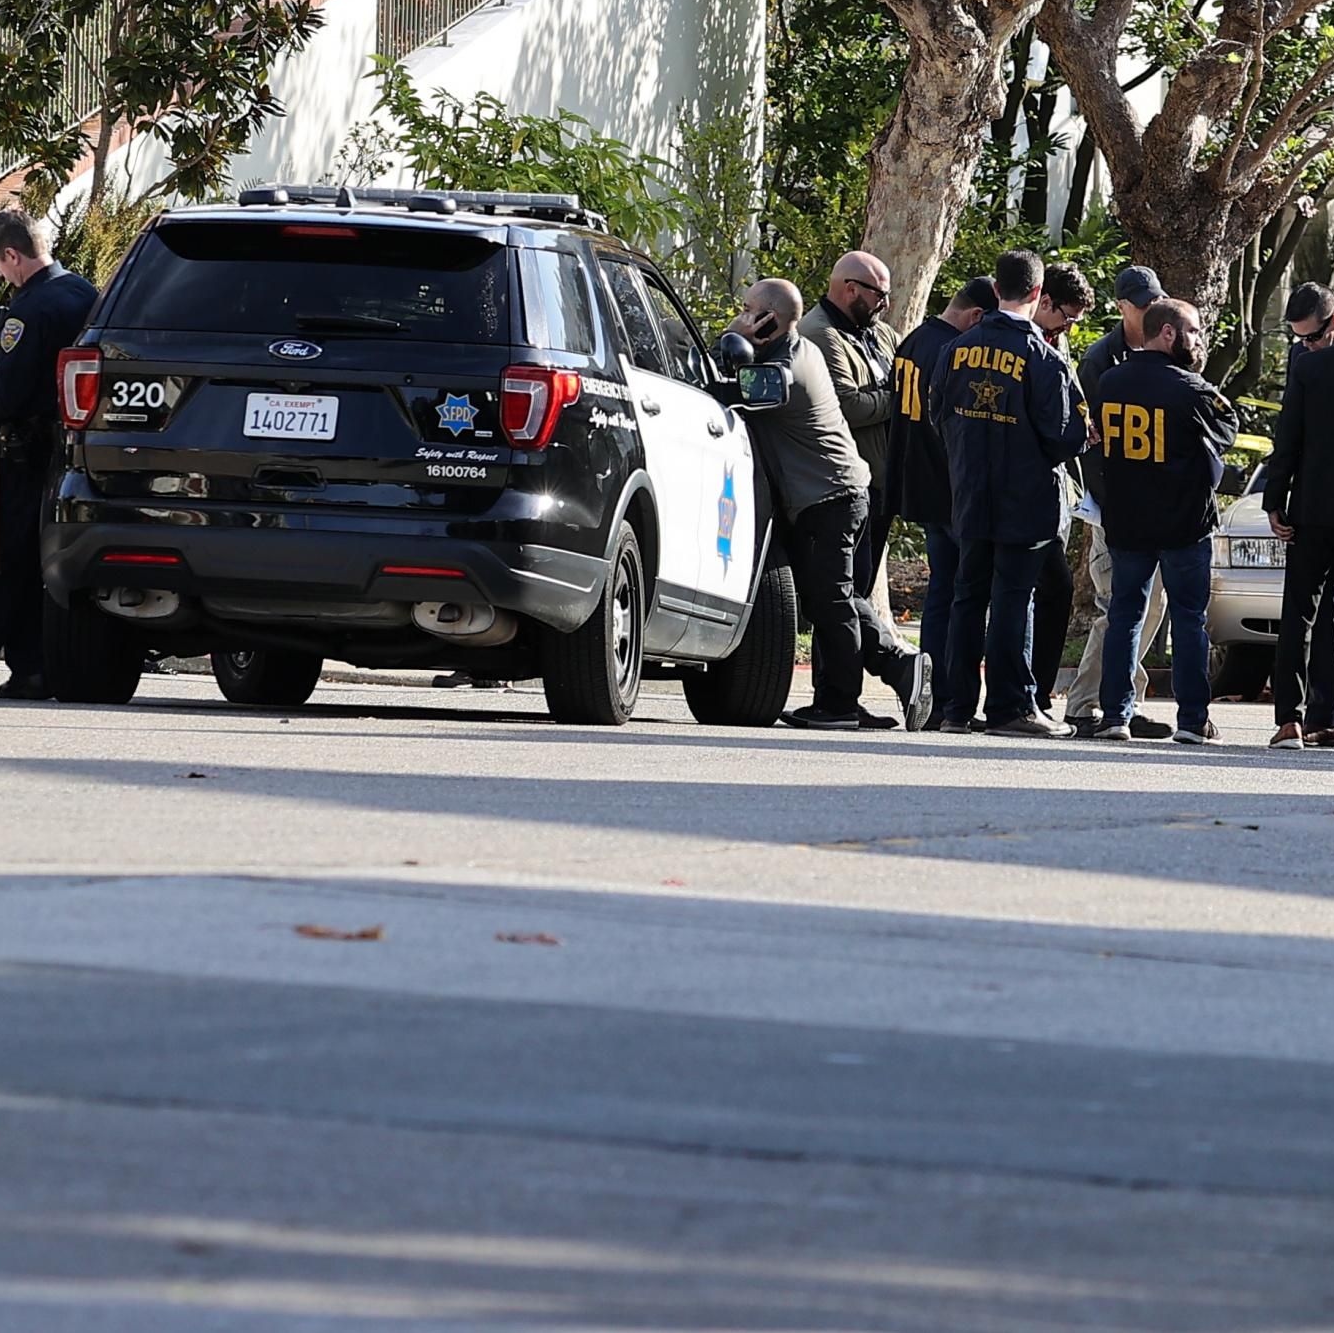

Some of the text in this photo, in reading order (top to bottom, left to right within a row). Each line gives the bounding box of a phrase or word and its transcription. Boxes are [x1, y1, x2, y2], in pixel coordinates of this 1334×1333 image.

[279, 343, 310, 356] Ford
[952, 346, 1027, 382] POLICE
[112, 381, 165, 408] 320
[284, 401, 316, 409] EXEMPT
[250, 409, 329, 433] 1402771
[964, 409, 991, 419] SECRET
[1101, 402, 1166, 463] FBI
[415, 447, 498, 462] Safety with Respect
[426, 465, 487, 479] 16100764
